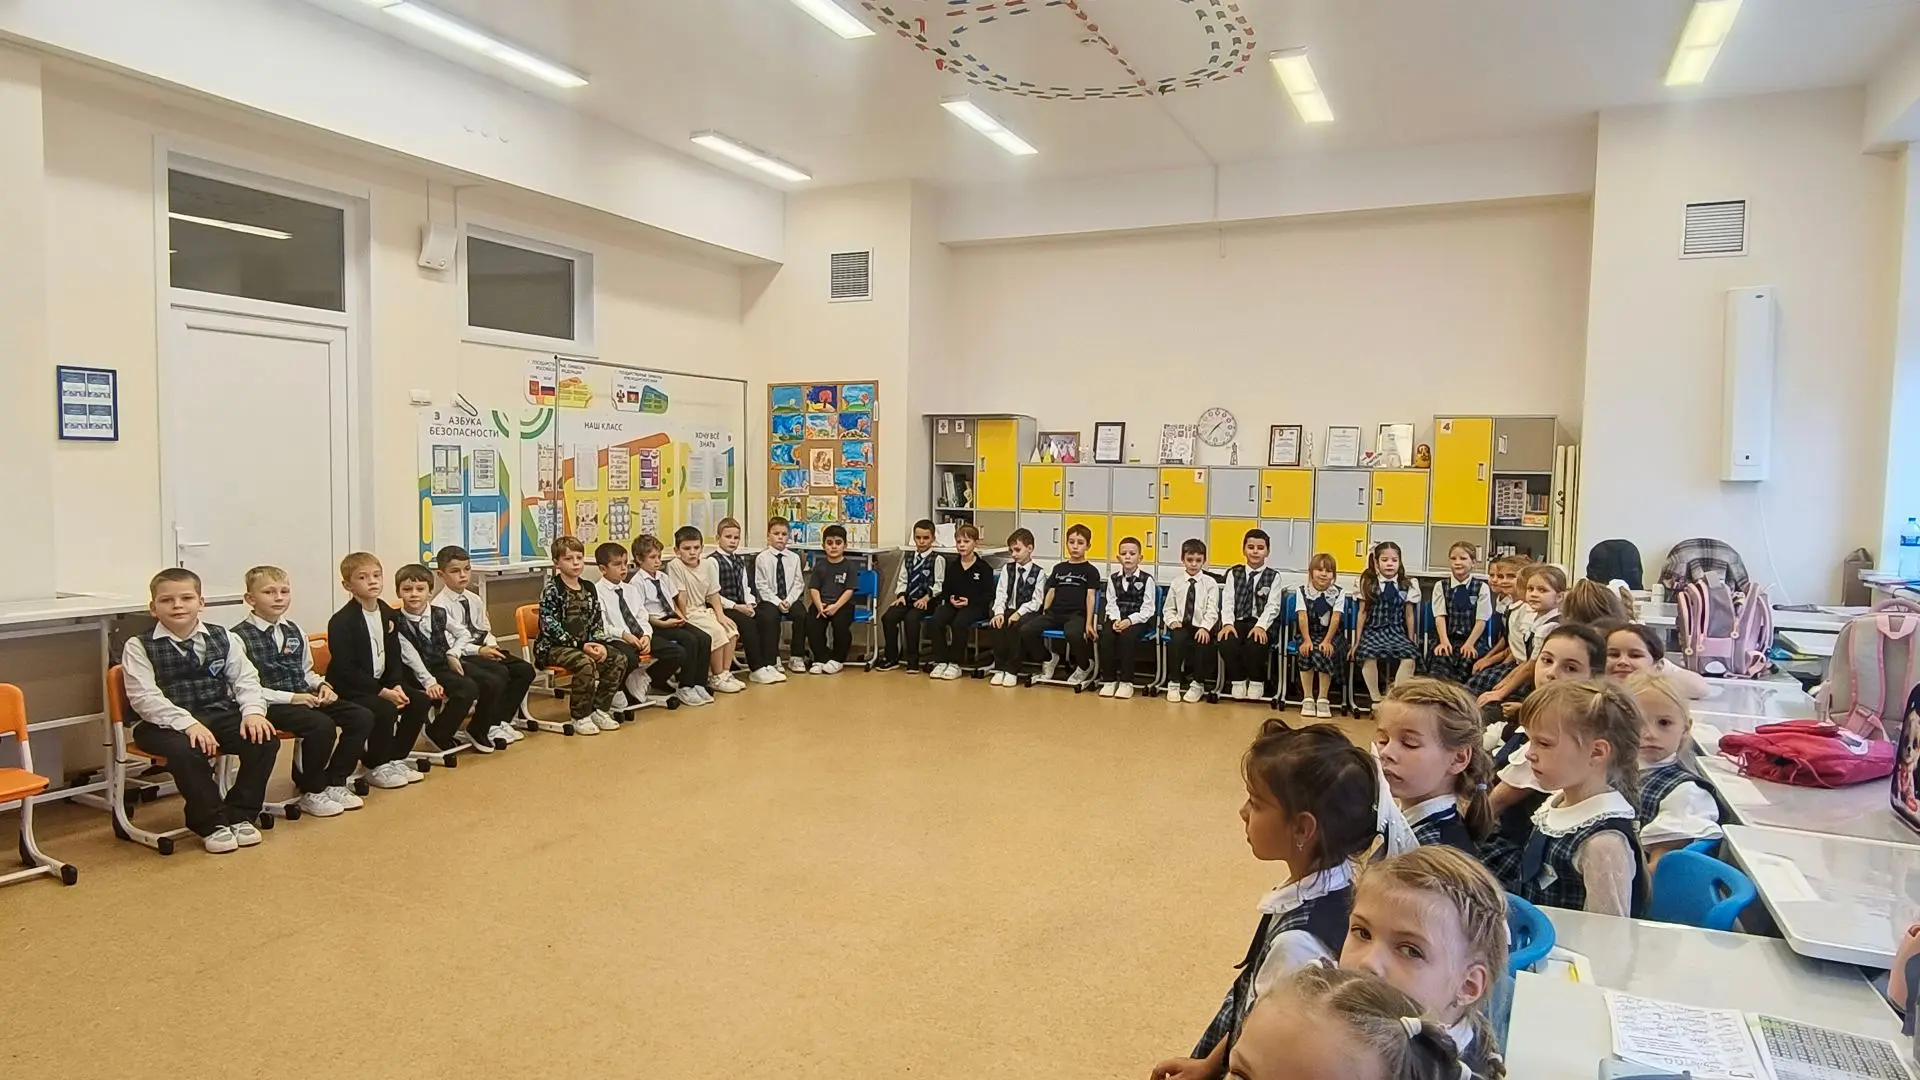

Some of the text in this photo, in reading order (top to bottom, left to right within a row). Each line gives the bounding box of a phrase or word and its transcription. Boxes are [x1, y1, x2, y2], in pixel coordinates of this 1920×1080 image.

[448, 416, 482, 426] АЗБУКА
[584, 421, 623, 431] НАШ КЛАСС
[1442, 422, 1451, 431] 4
[429, 426, 500, 438] БЕЗОПАСНОСТИ
[699, 440, 716, 449] ЗНАТЬ
[1197, 471, 1203, 480] 7
